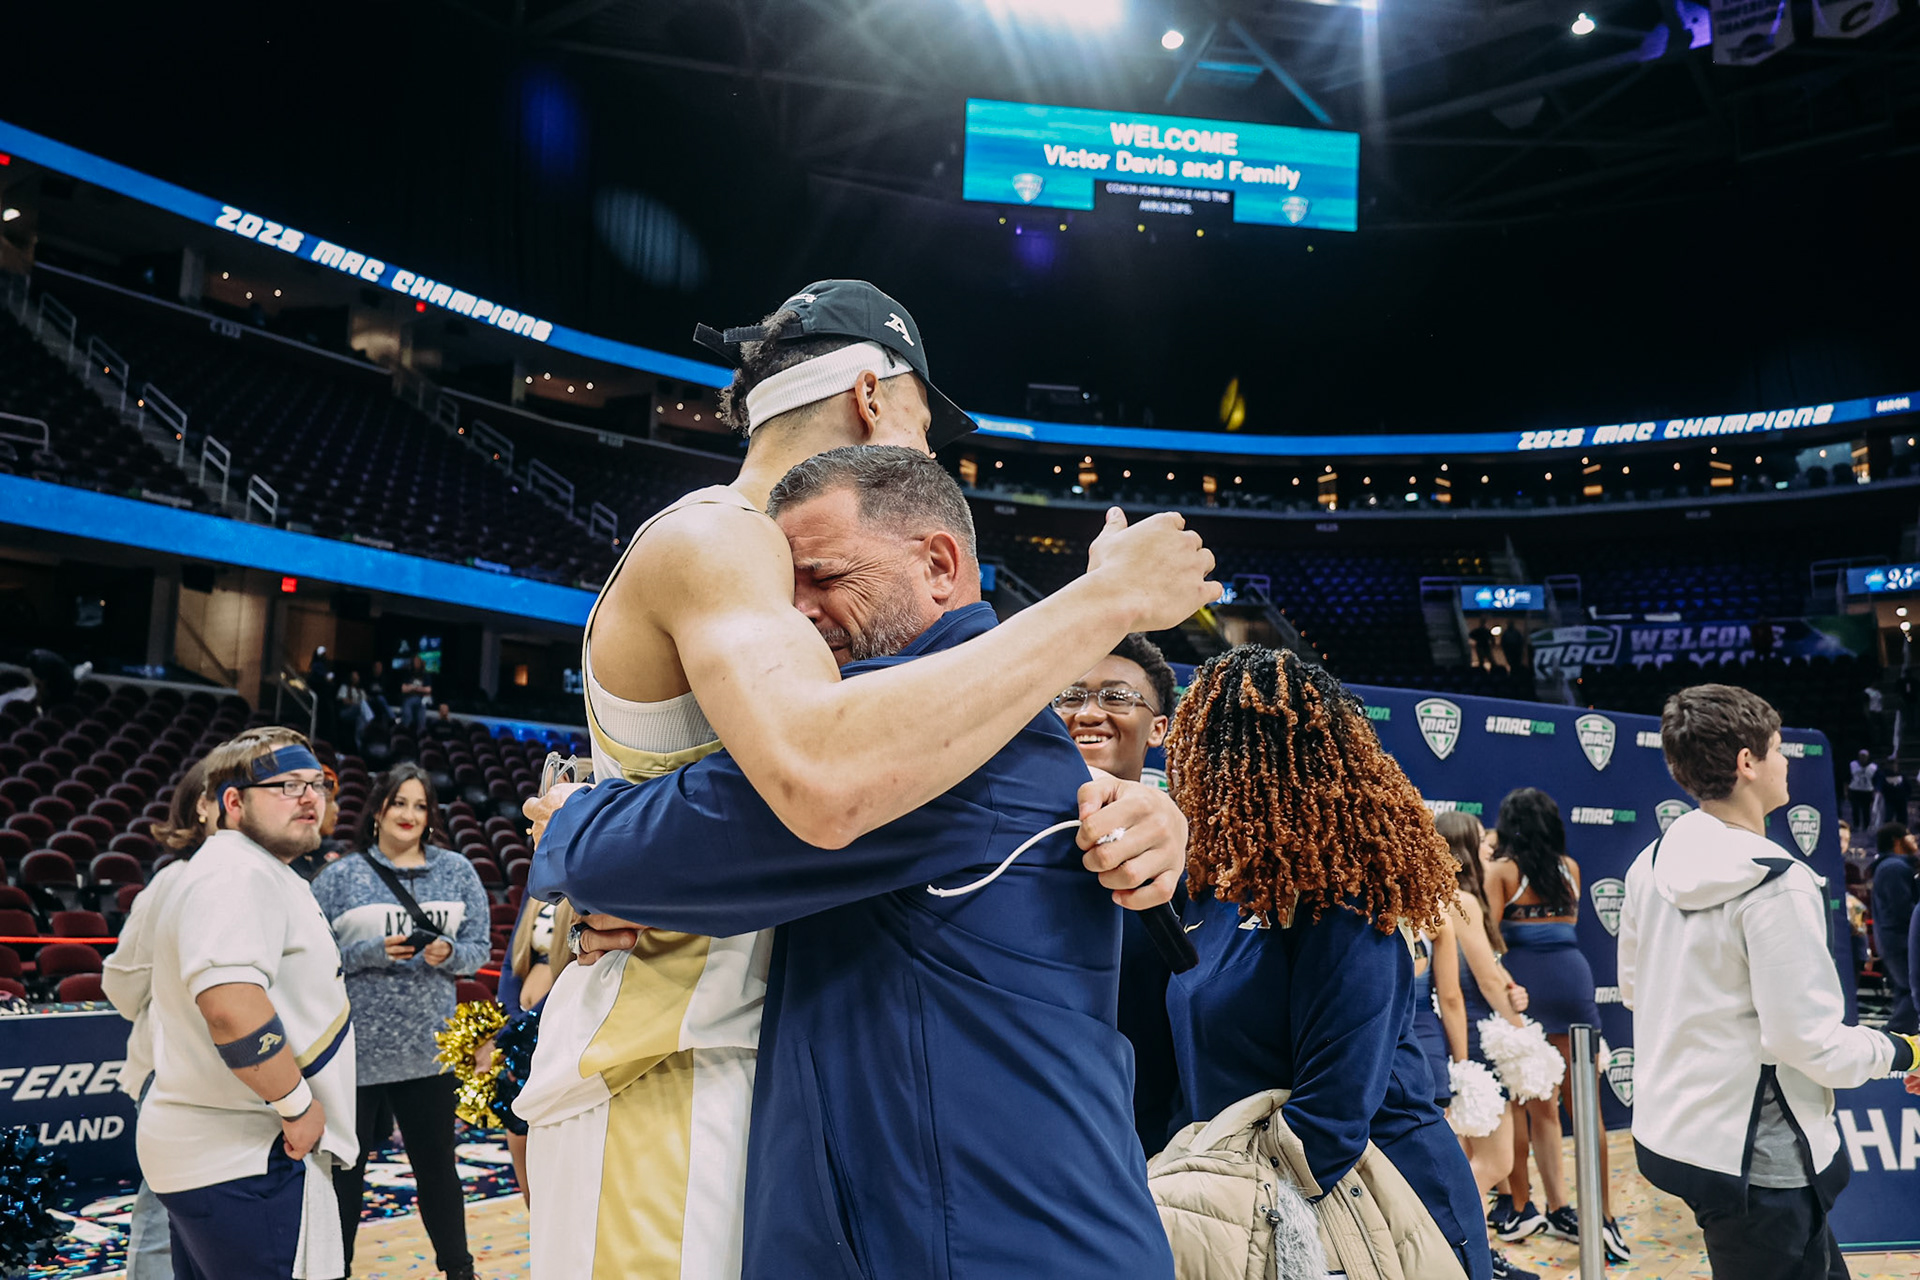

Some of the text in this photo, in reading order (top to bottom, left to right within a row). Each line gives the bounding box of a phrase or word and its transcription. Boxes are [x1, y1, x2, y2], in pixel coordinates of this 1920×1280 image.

[1110, 122, 1238, 156] WELCOME
[1043, 144, 1300, 191] Victor Davis and Family
[215, 205, 553, 343] 2025 MAC CHAMPIONS
[884, 312, 915, 347] A
[1517, 404, 1834, 451] 2025 MAC CHAMPIONS
[1423, 717, 1457, 733] MAC
[1582, 731, 1612, 746] MAC
[1792, 821, 1818, 835] MAC
[385, 910, 448, 937] AKN
[257, 1032, 282, 1055] A
[1610, 1067, 1632, 1082] MA
[38, 1116, 125, 1146] LAND
